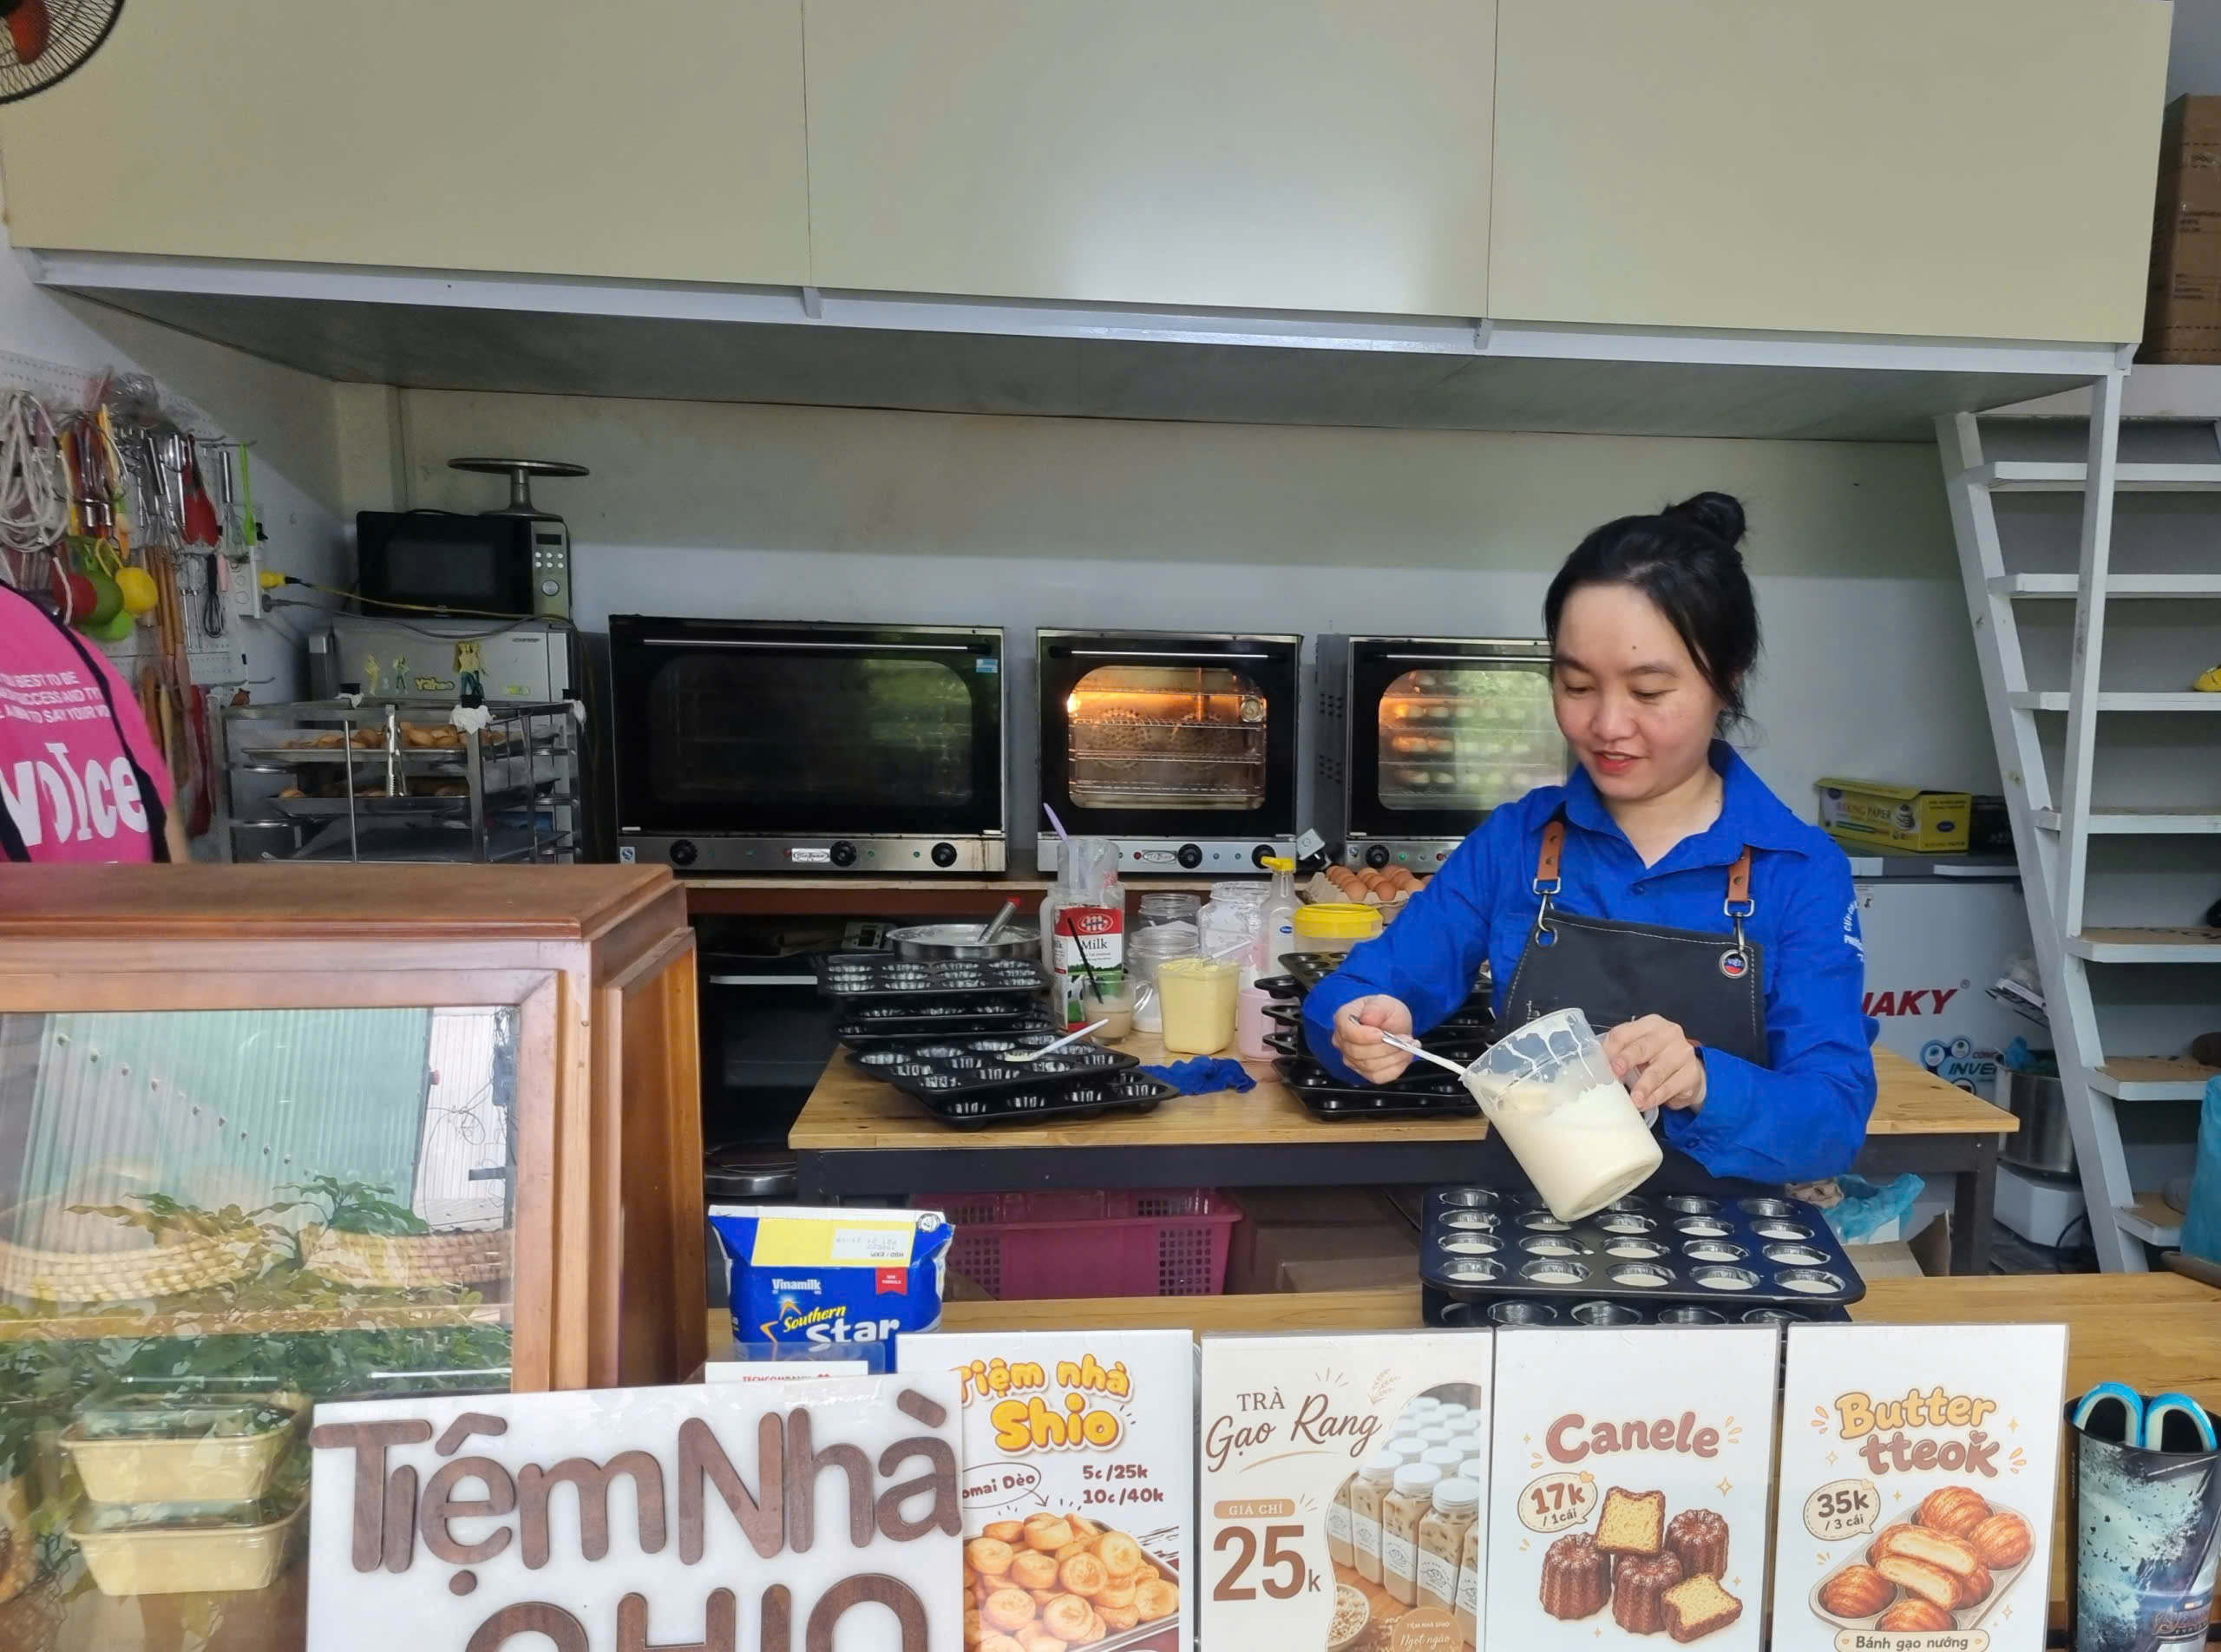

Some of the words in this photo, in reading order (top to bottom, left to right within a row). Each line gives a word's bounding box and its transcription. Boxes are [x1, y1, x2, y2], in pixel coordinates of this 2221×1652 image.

[1081, 938, 1108, 950] Milk
[1862, 988, 1958, 1017] AKY
[1948, 1062, 1997, 1076] INVE
[772, 1279, 821, 1291] Vinamilk
[783, 1305, 847, 1333] Southern
[1057, 1354, 1130, 1398] nhà
[1237, 1387, 1285, 1412] TRÀ
[1835, 1386, 1996, 1439] Butter
[991, 1392, 1119, 1452] Shio
[1206, 1416, 1276, 1472] Gạo
[1290, 1393, 1382, 1458] Rang
[1546, 1411, 1720, 1464] Canele
[1859, 1430, 2000, 1478] tteok
[1228, 1502, 1254, 1516] GIÁ
[1530, 1482, 1585, 1515] 17k
[1817, 1490, 1869, 1518] 35k
[1856, 1636, 1890, 1649] Bánh
[1897, 1639, 1921, 1652] gạo
